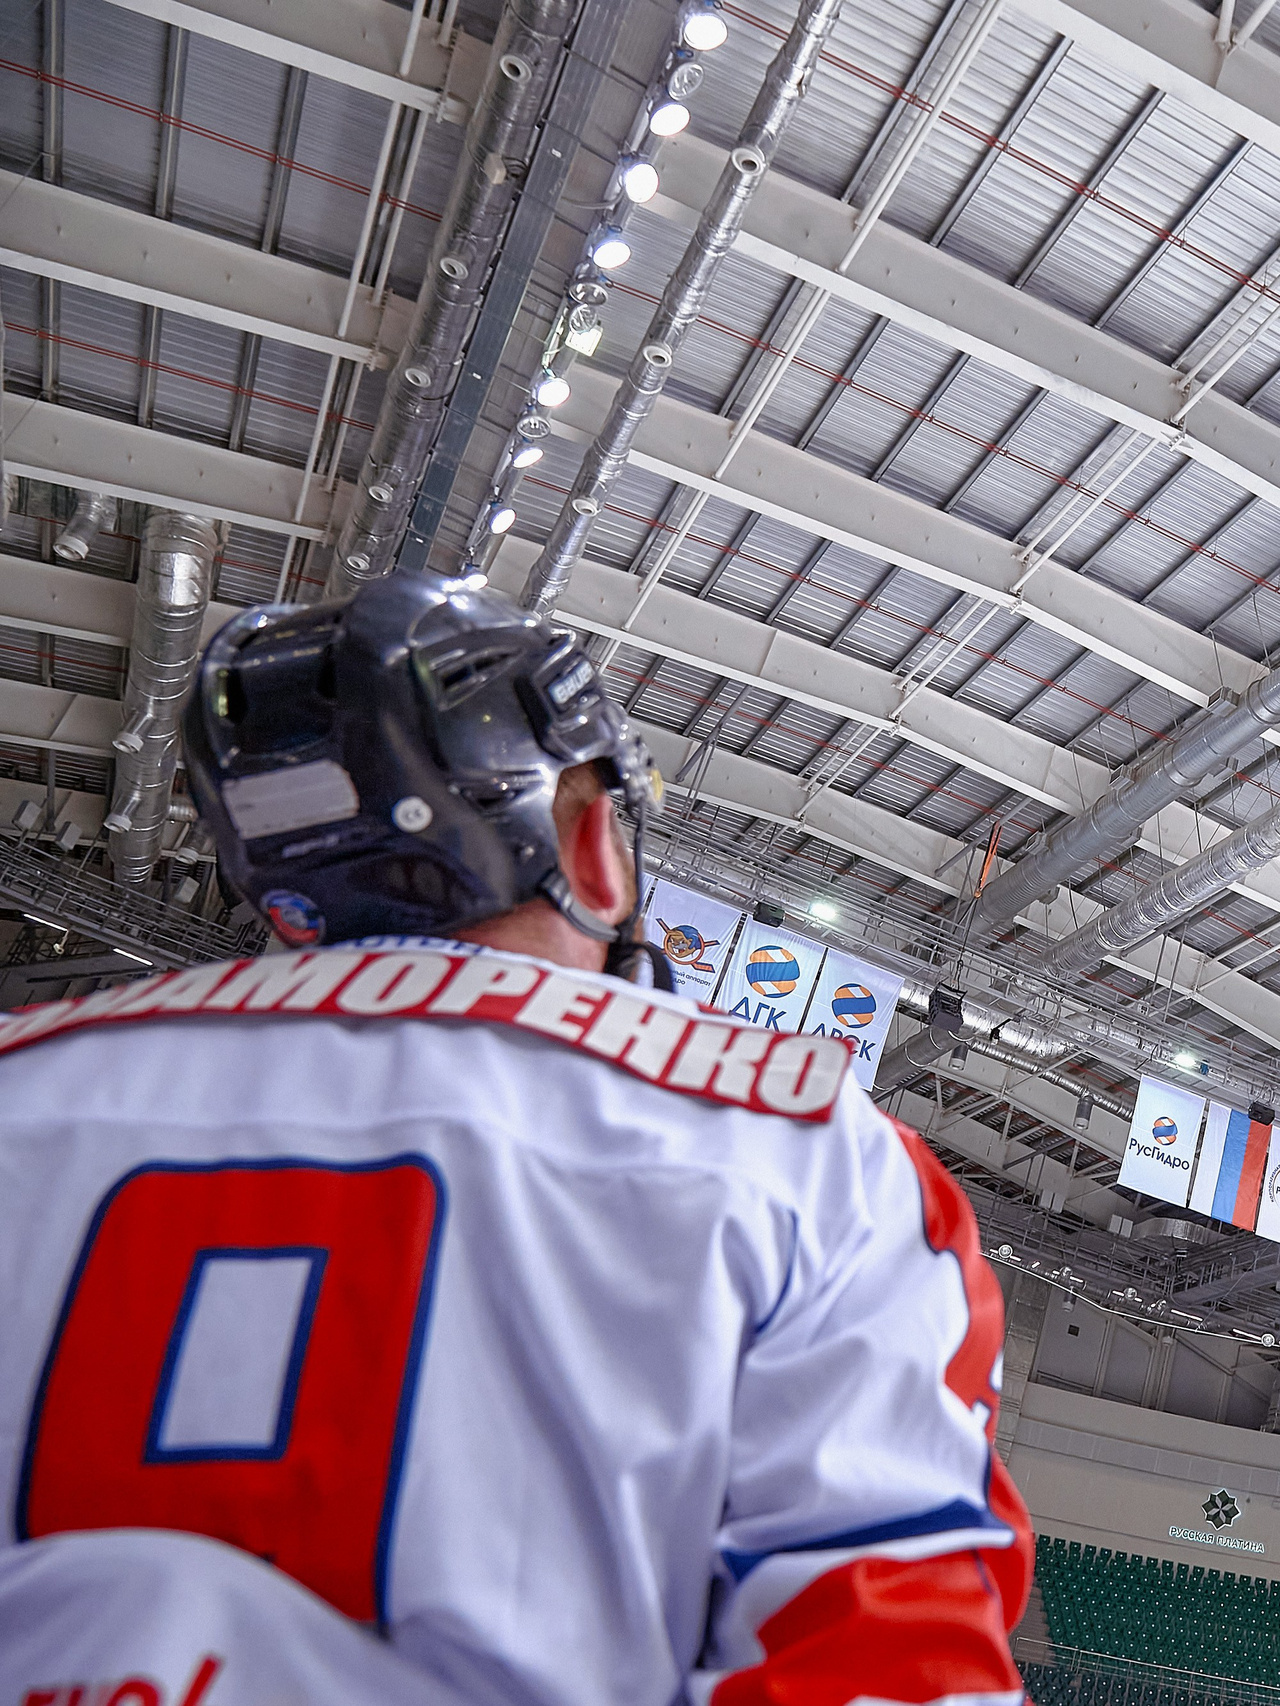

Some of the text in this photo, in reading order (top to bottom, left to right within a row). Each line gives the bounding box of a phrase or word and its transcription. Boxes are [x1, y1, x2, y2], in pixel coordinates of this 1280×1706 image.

[728, 996, 787, 1032] ДГК
[1128, 1137, 1190, 1171] РусГидро
[1168, 1525, 1265, 1554] РУССКАЯ ПЛАТИНА
